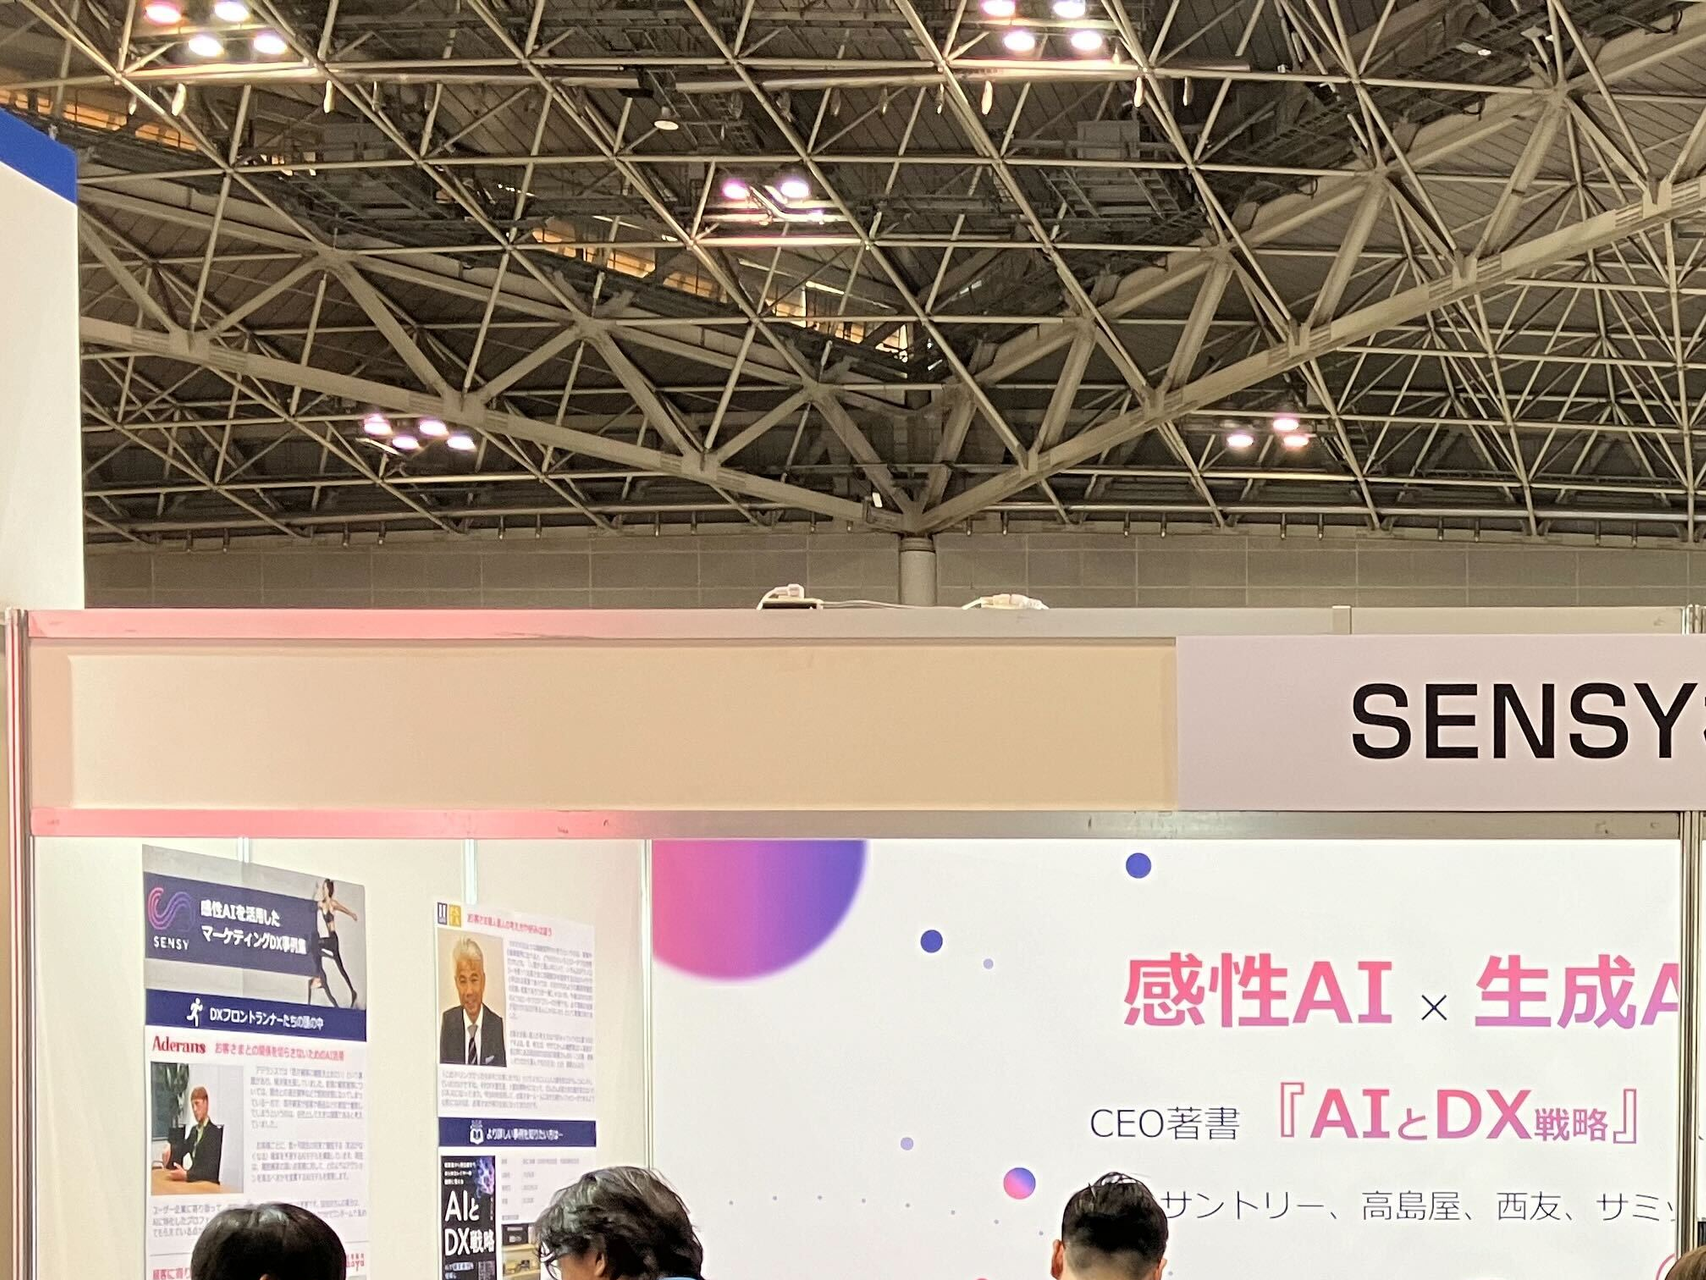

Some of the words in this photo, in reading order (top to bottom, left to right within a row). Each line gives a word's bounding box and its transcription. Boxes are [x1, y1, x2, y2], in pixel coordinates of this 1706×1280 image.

[153, 935, 190, 950] SENSY
[1124, 953, 1393, 1029] 感性AI
[153, 1035, 206, 1054] Aderans
[1090, 1107, 1241, 1142] CEO著書
[1281, 1082, 1639, 1145] 『AIとDX戦略』
[444, 1190, 480, 1222] AIと
[444, 1227, 495, 1256] DX戦略
